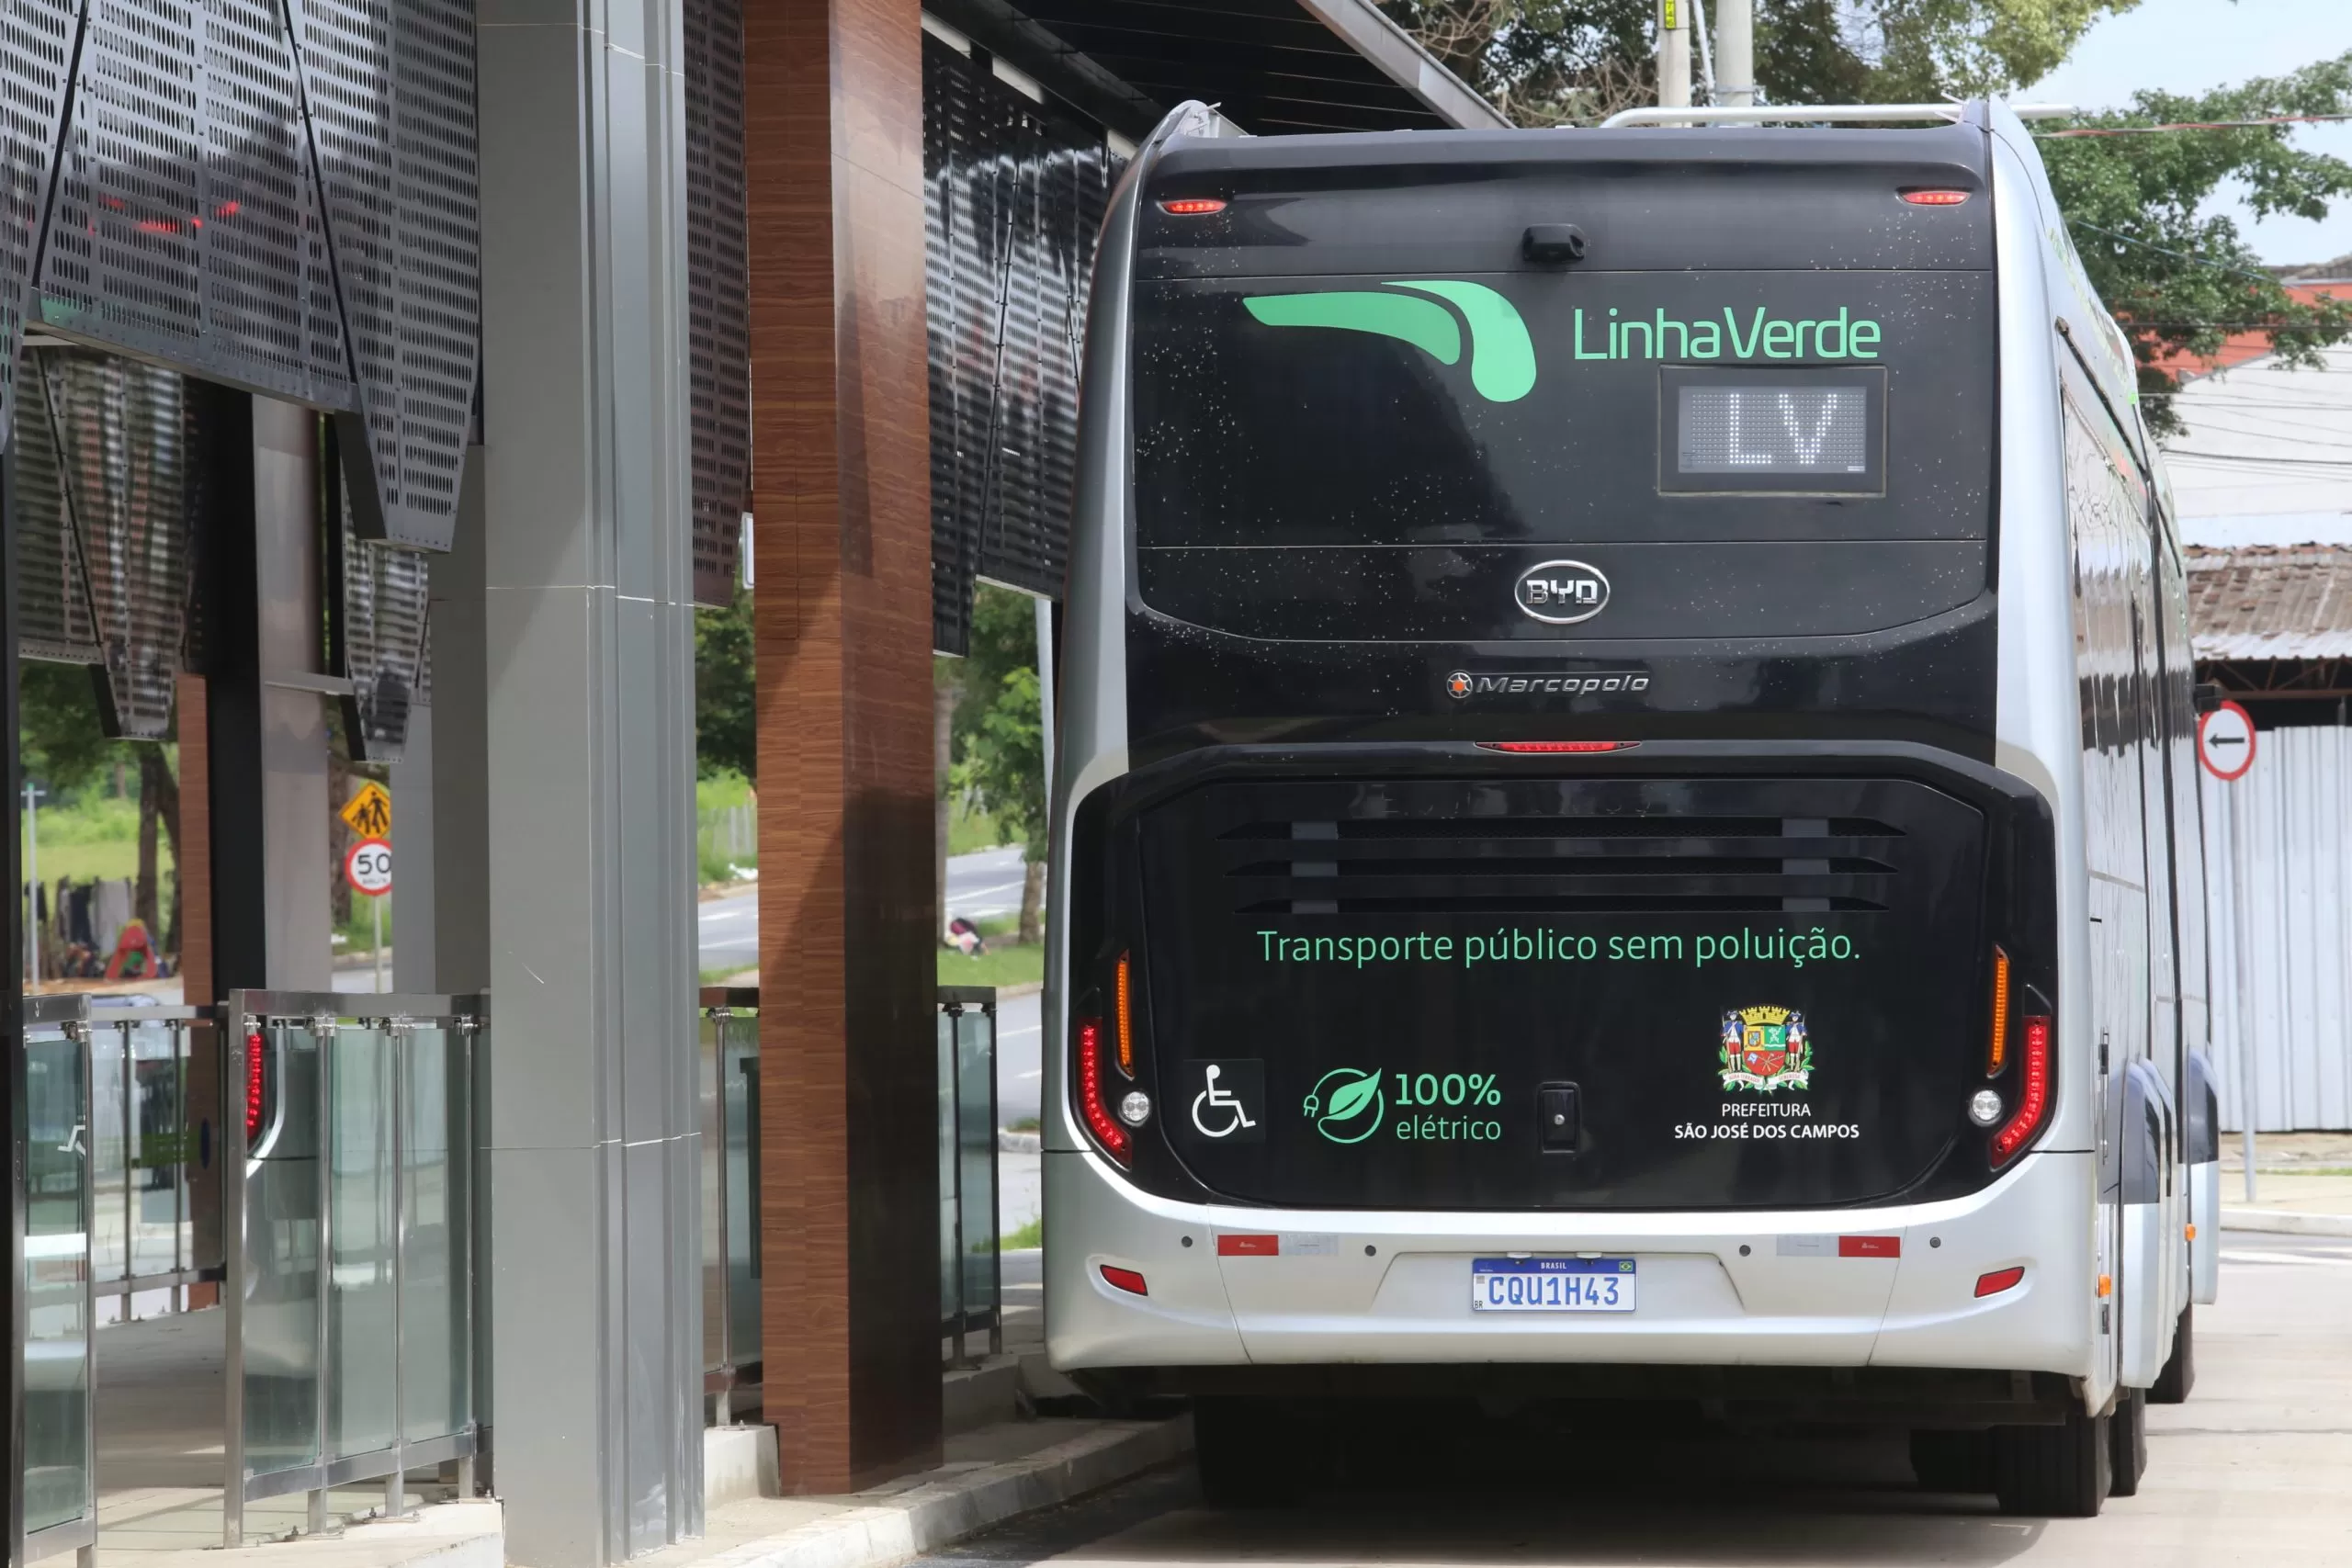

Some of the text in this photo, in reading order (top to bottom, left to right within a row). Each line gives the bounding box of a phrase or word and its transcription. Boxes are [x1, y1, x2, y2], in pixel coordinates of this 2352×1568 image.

[1574, 306, 1882, 360] LinhaVerde
[1729, 393, 1838, 465] LV
[1525, 580, 1599, 604] BYD
[1476, 675, 1650, 695] Marcopolo
[357, 853, 391, 874] 50
[1257, 926, 1860, 969] Transporte público sem poluição.
[1396, 1074, 1501, 1106] 100%
[1722, 1103, 1811, 1117] PREFEITURA
[1396, 1114, 1501, 1141] elétrico
[1675, 1122, 1860, 1139] SÃO JOSÉ DOS CAMPOS
[1541, 1261, 1567, 1269] BRASIL
[1488, 1276, 1619, 1305] CQU1H43
[1474, 1301, 1484, 1310] BR
